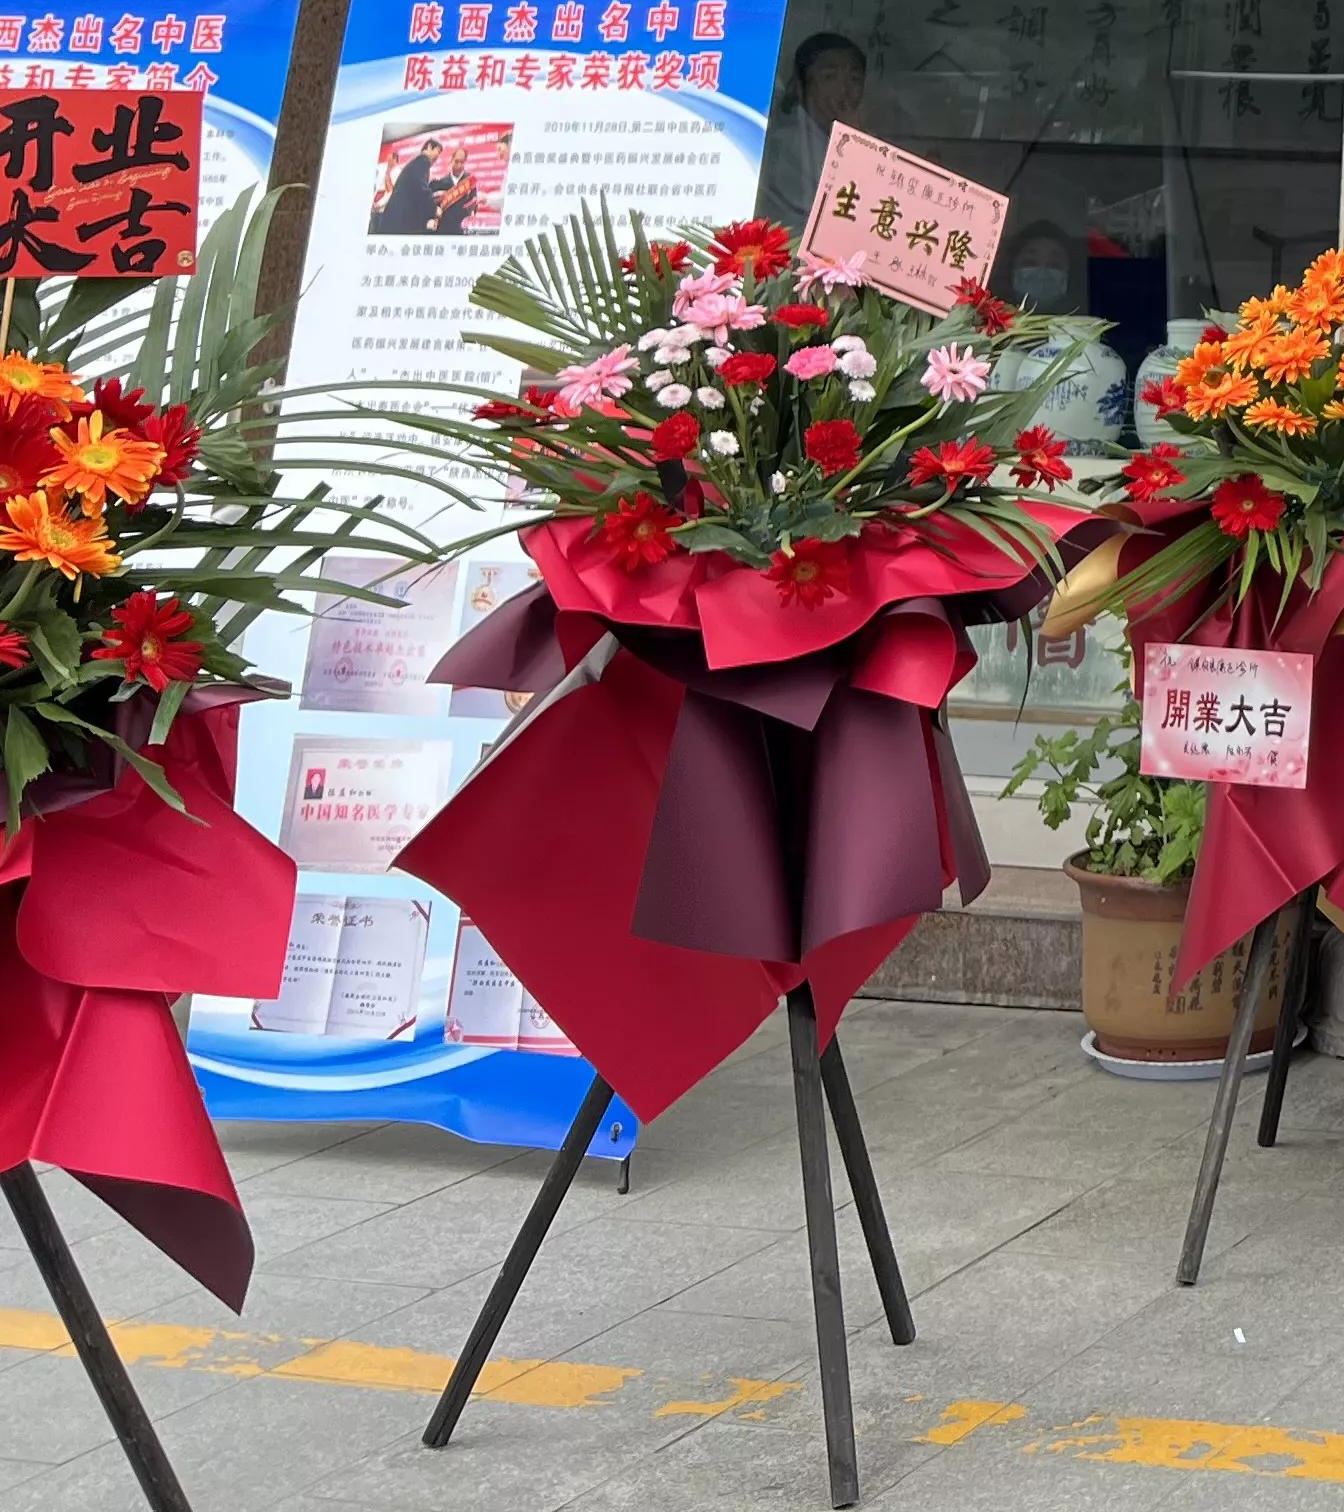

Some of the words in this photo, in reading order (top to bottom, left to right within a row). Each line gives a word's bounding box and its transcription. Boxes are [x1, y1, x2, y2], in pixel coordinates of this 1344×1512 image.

[409, 0, 728, 43] 陕西杰出名中医
[403, 52, 723, 92] 陈益和专家荣获奖项
[832, 179, 979, 273] 生意兴隆
[1160, 688, 1292, 738] 開業大吉
